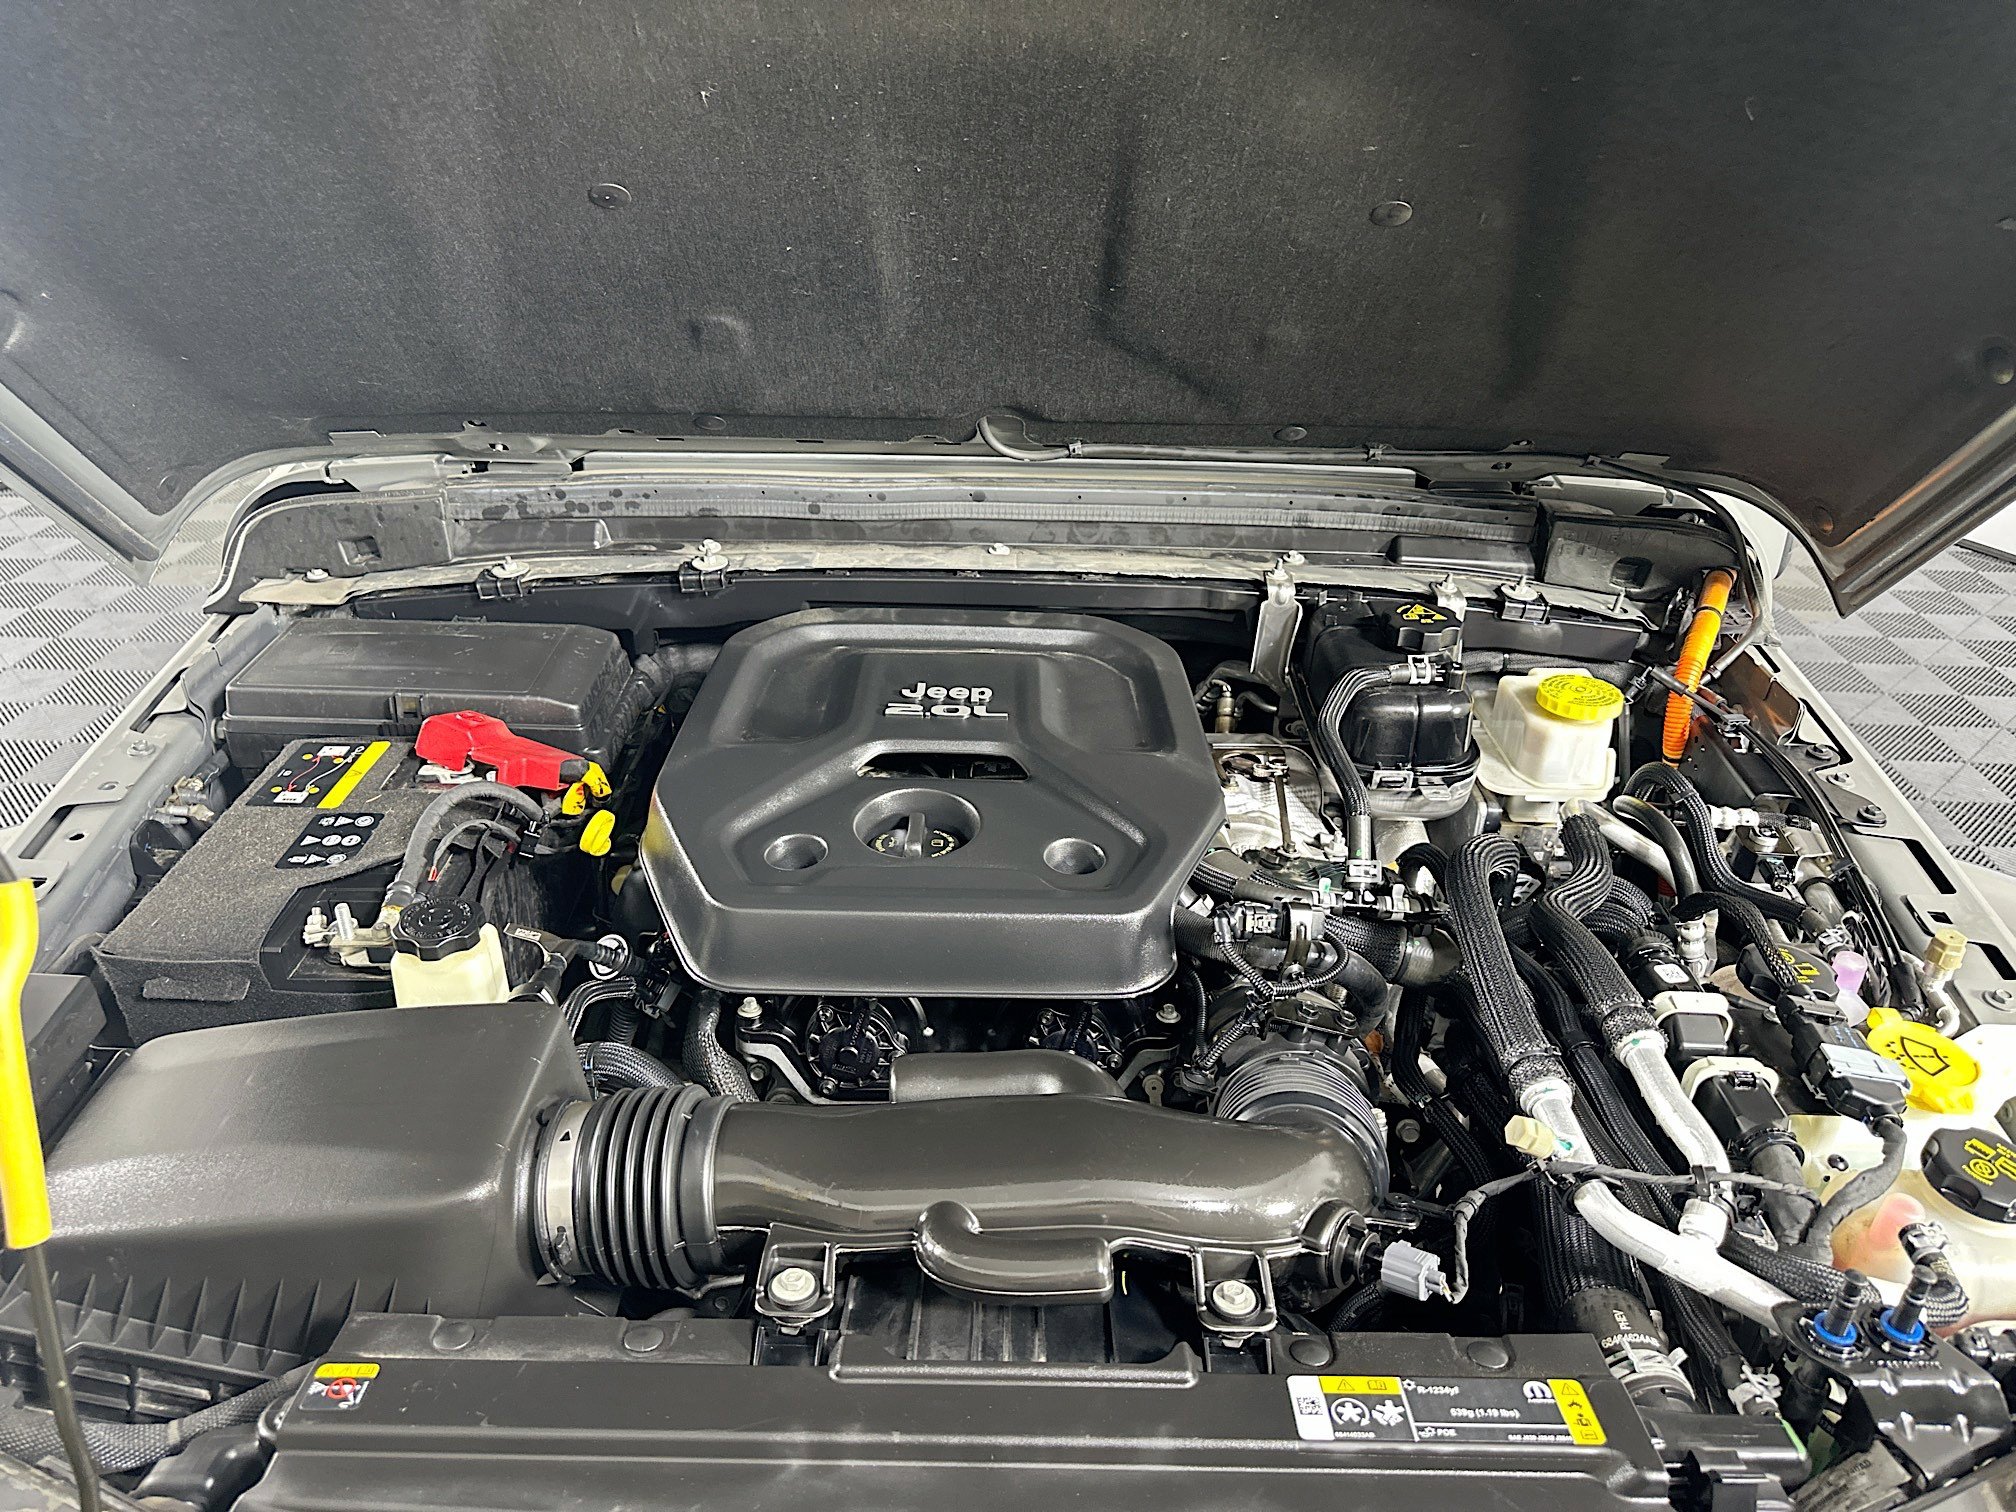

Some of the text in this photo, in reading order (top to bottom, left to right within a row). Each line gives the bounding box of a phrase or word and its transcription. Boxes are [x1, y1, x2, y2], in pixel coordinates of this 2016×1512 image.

[901, 682, 993, 703] Jeep
[884, 702, 1009, 719] 2.0L
[1612, 1309, 1632, 1330] PHEV
